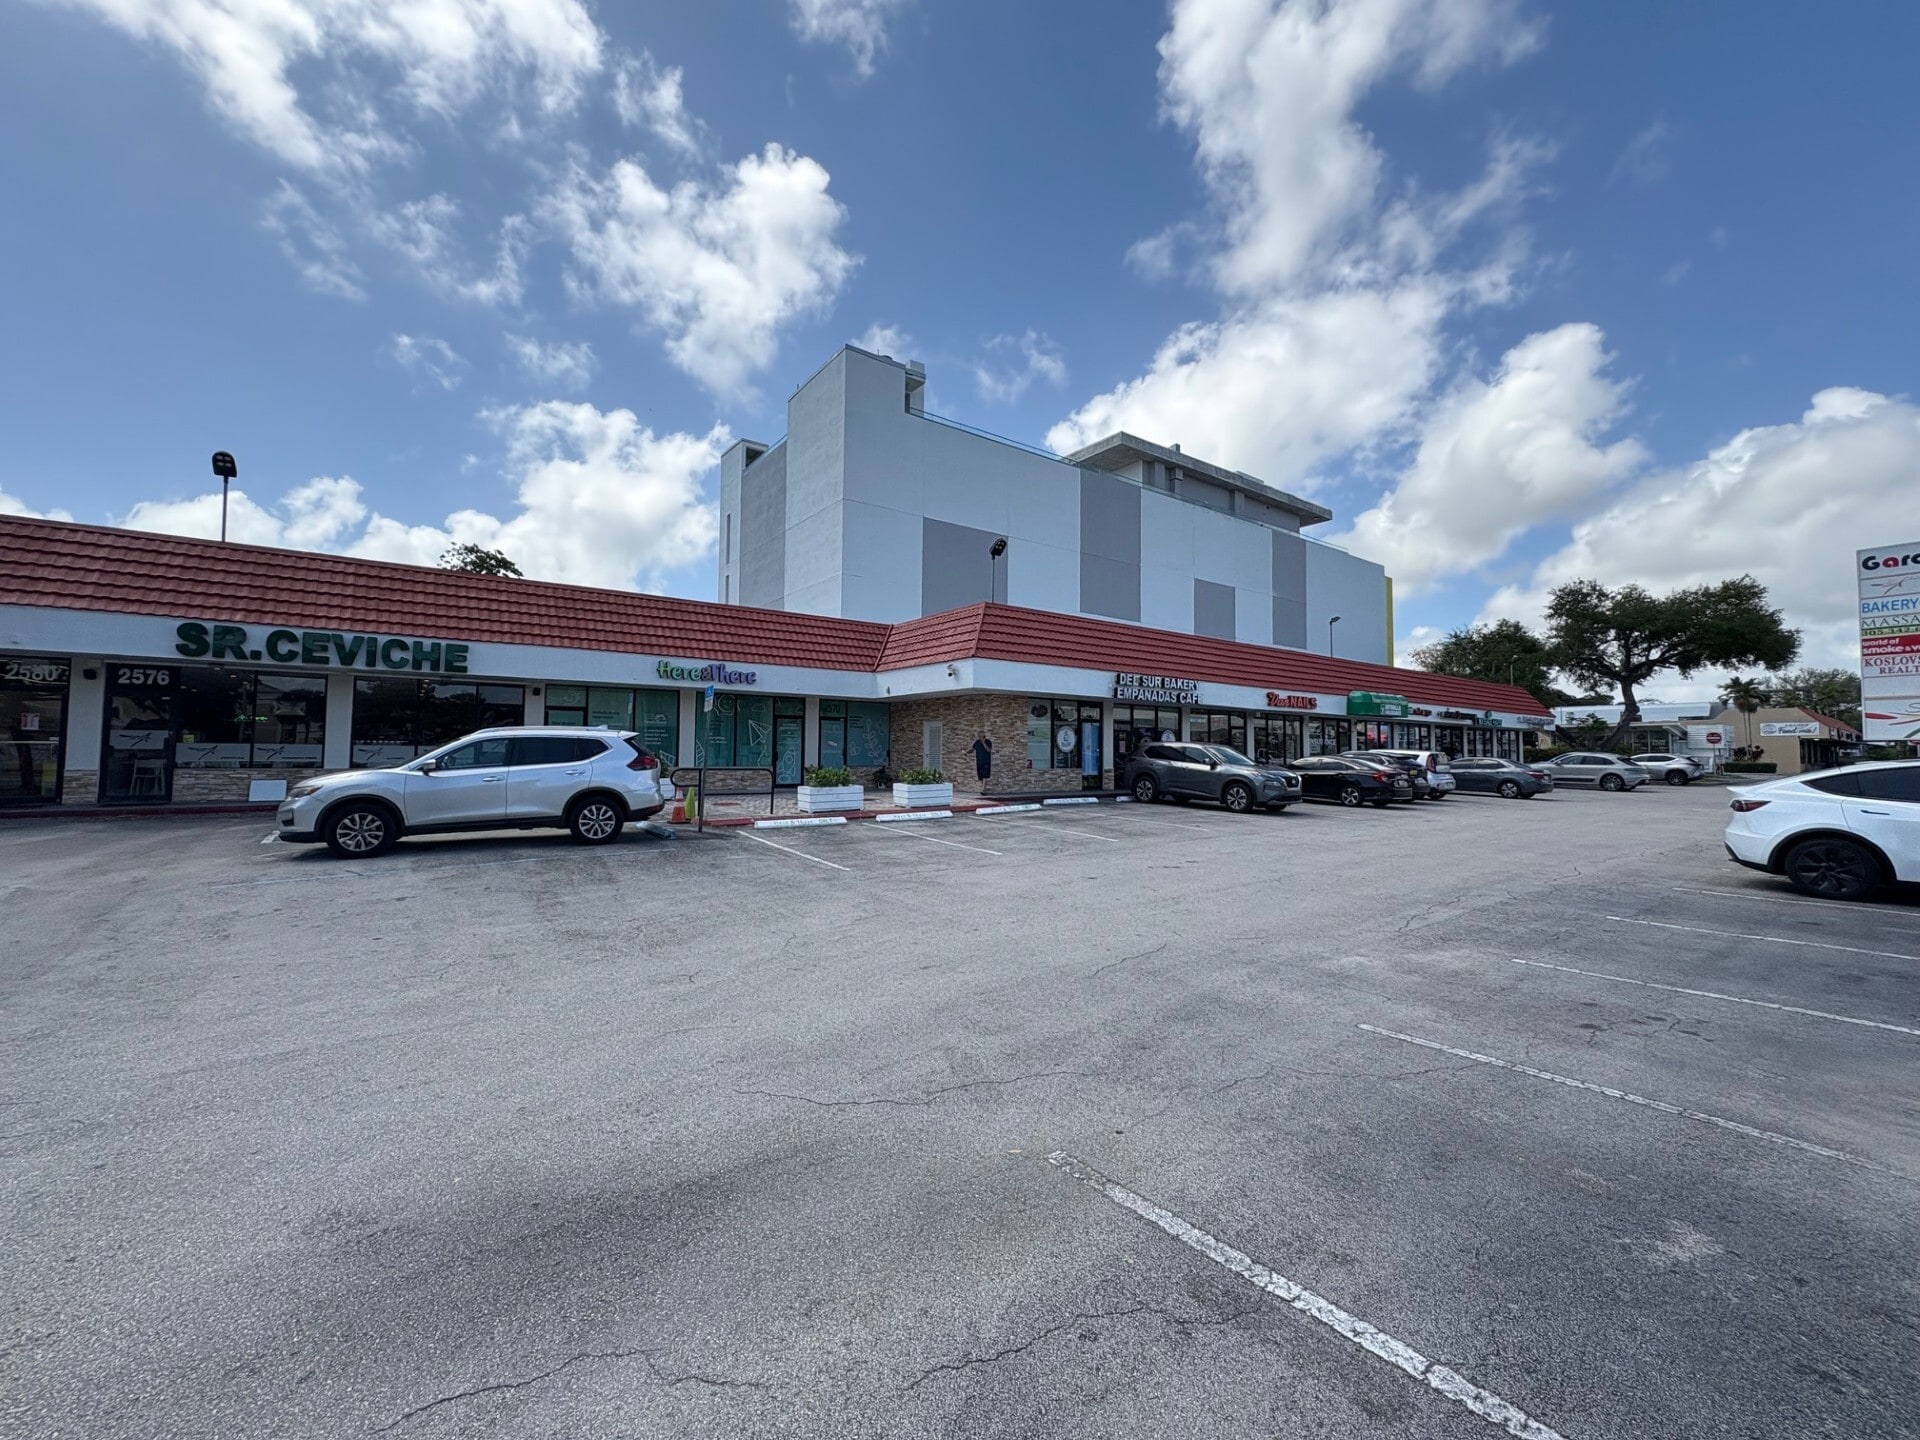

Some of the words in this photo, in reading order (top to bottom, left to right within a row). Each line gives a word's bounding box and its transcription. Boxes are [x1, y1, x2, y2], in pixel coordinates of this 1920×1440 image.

[1862, 598, 1918, 613] BAKERY
[1863, 645, 1904, 654] smoke
[118, 668, 170, 685] 2576
[1120, 673, 1139, 685] DEL
[1142, 675, 1161, 688] SUR
[1164, 677, 1200, 690] BAKERY
[1117, 687, 1177, 702] EMPANADAS
[1287, 695, 1317, 709] NAILS
